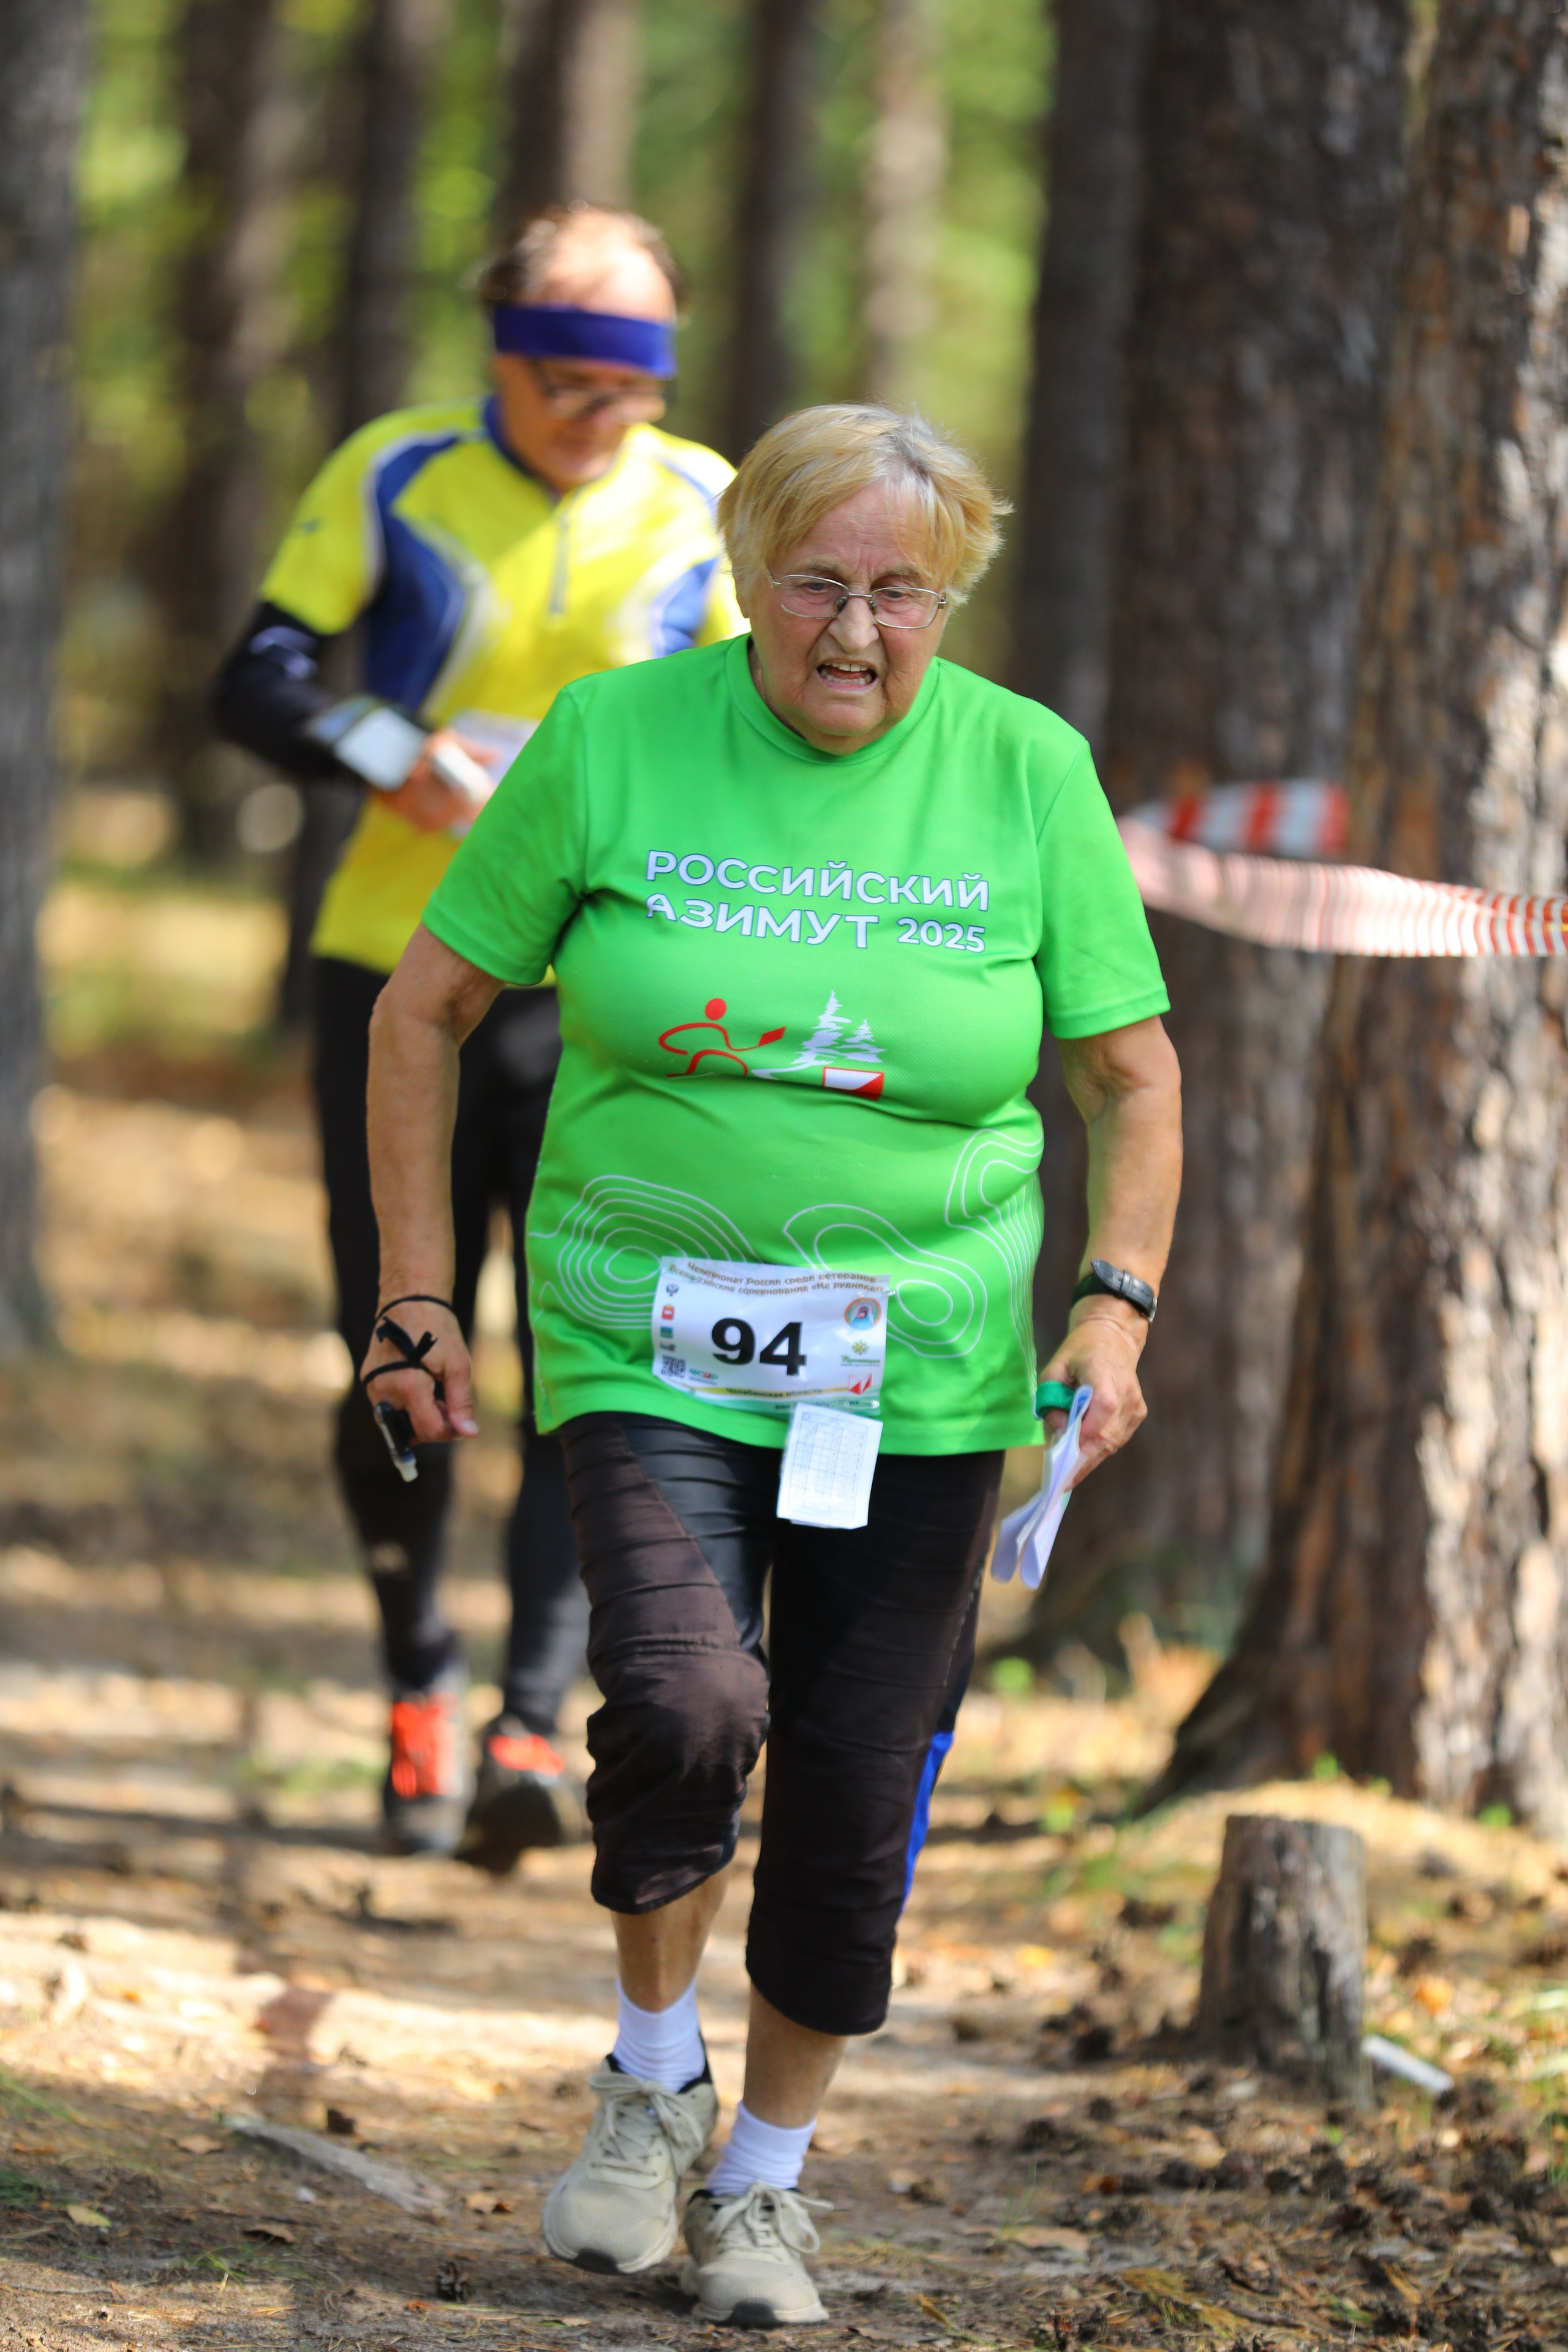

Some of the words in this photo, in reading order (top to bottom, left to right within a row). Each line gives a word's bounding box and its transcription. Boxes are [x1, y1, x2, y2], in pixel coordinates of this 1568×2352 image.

[646, 850, 989, 911] РОССИЙСКИЙ
[646, 892, 880, 949] АЗИМУТ
[897, 917, 986, 952] 2025
[688, 1261, 744, 1284] Чемпионат
[747, 1277, 781, 1286] России
[785, 1275, 815, 1284] среди
[819, 1273, 876, 1283] ветеранов
[739, 1286, 808, 1296] соревнования
[712, 1317, 807, 1376] 94
[726, 1387, 783, 1398] Челябинская
